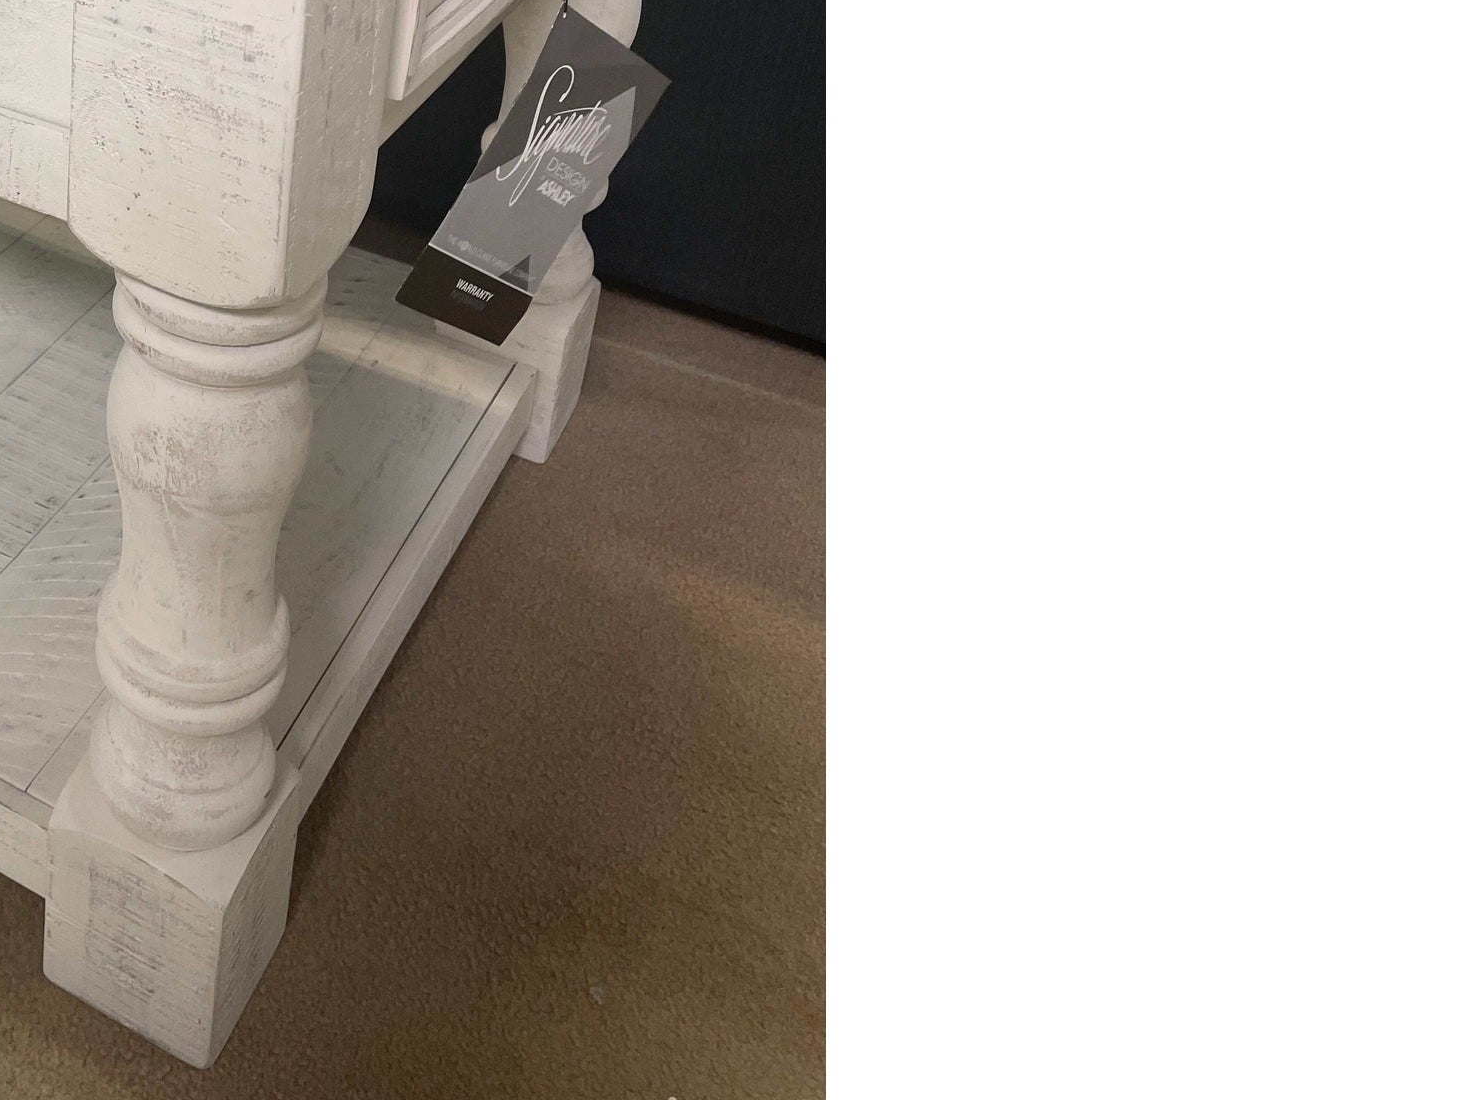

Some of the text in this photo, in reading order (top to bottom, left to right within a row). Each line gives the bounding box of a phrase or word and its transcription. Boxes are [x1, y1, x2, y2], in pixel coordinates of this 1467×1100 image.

[546, 156, 590, 192] DESIGN
[536, 179, 576, 207] ASHLEY
[455, 278, 494, 302] WARRANTY
